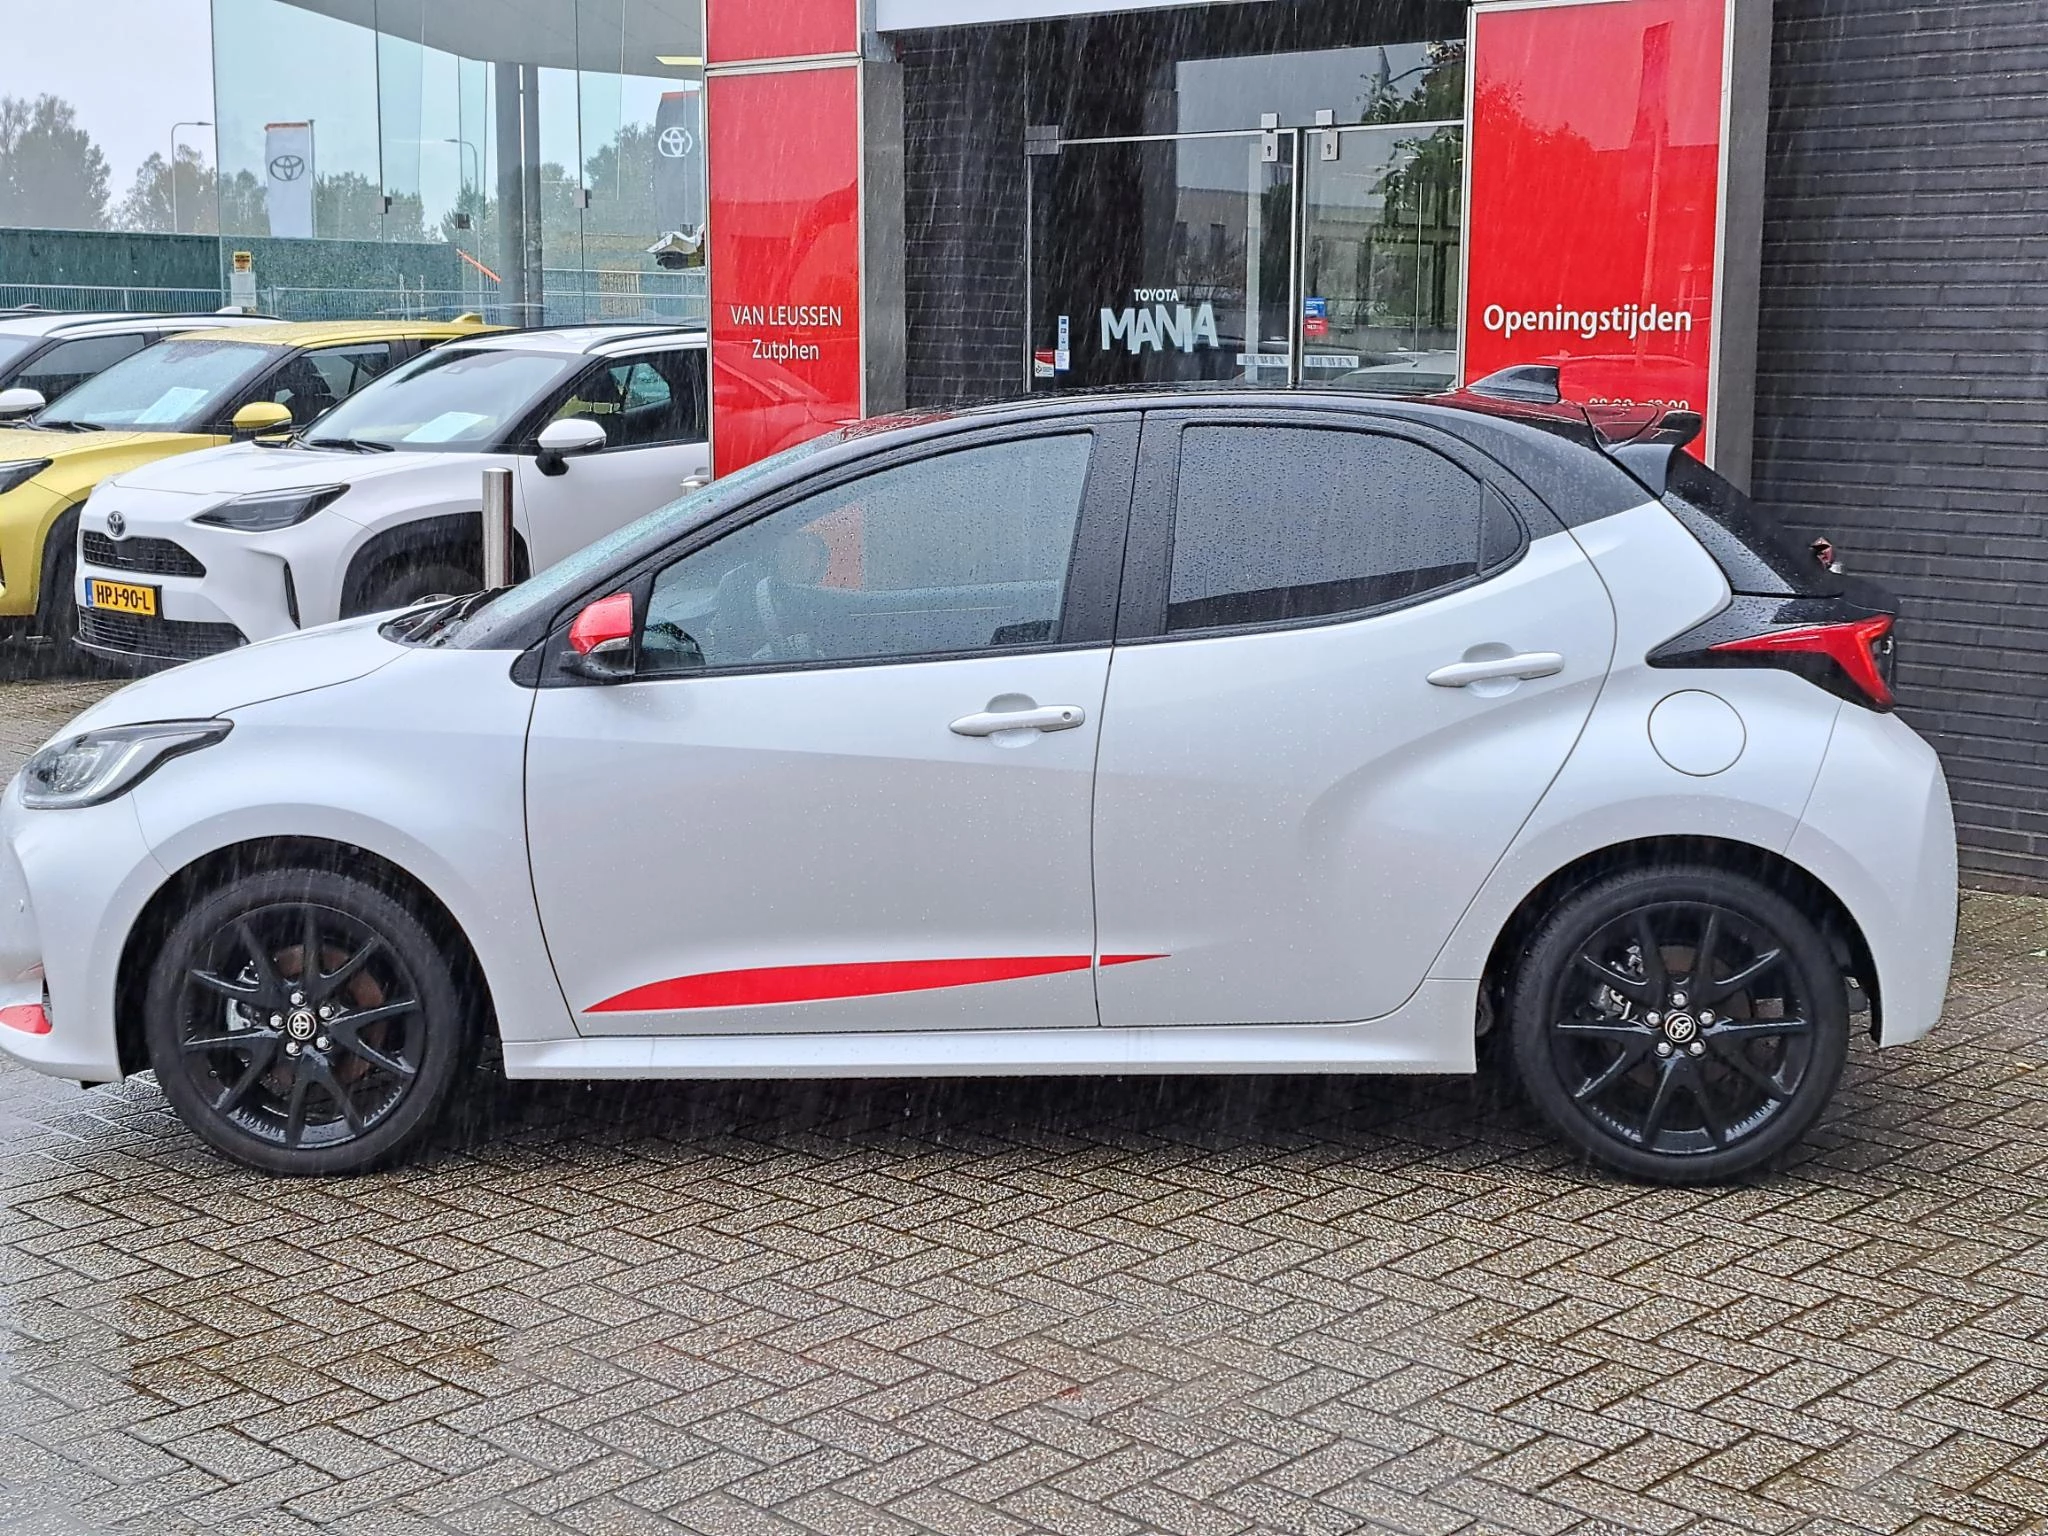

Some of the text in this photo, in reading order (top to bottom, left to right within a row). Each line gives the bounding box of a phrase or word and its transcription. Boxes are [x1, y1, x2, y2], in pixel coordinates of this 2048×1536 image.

[1133, 288, 1179, 302] TOYOTA
[730, 305, 842, 327] VAN LEUSSEN
[1100, 303, 1219, 355] MANIA
[1483, 303, 1692, 339] Openingstijden
[752, 338, 820, 364] Zutphen
[96, 584, 151, 611] HPJ-90-L
